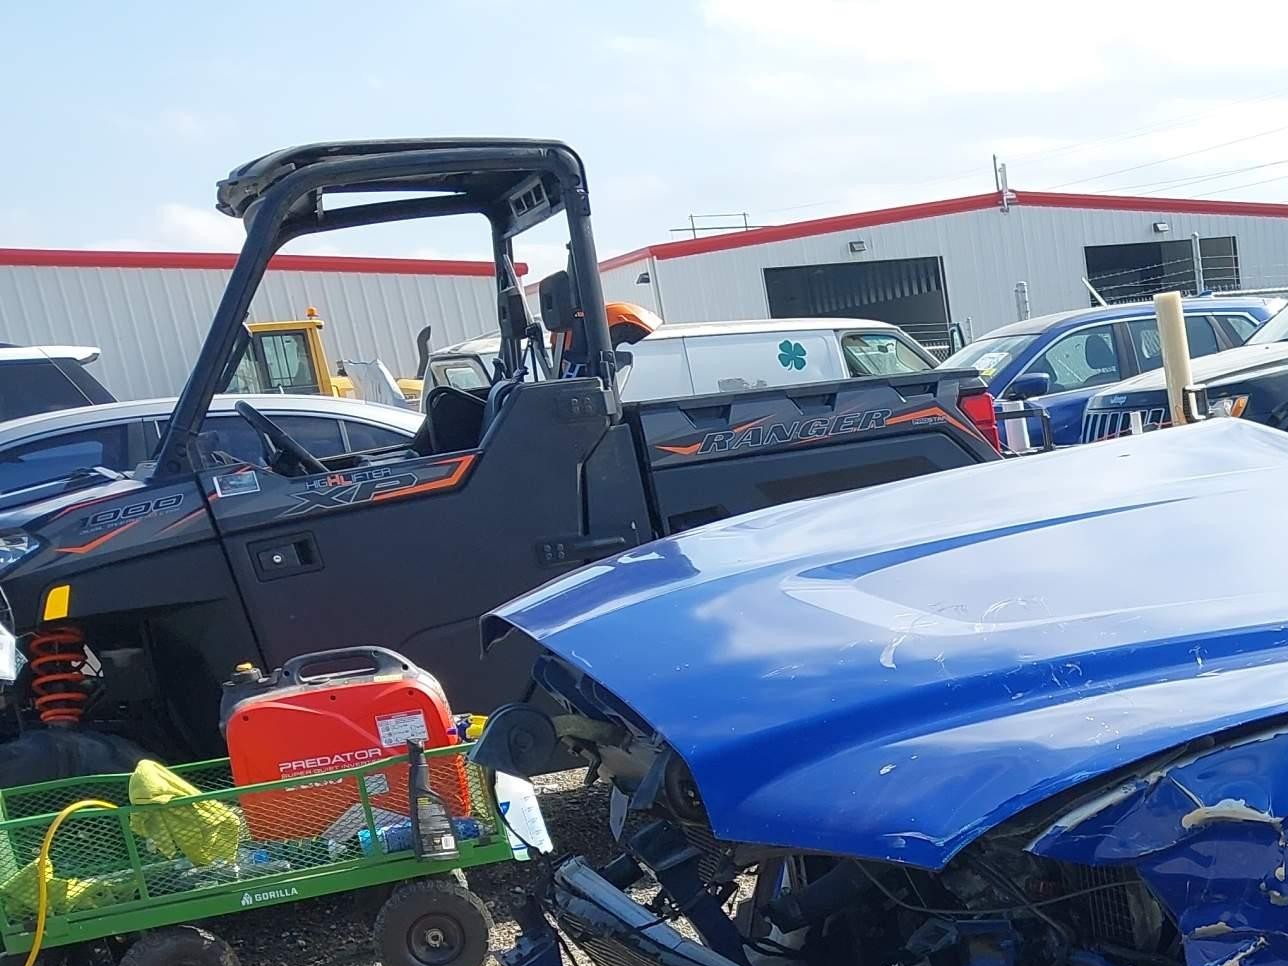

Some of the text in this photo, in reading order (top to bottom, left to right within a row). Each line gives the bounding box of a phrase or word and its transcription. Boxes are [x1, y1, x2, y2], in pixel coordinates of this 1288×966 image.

[697, 408, 892, 455] RANGER
[80, 494, 184, 529] 1000
[278, 472, 418, 517] XP
[279, 748, 382, 773] PREDATOR
[254, 887, 298, 902] GORILLA
